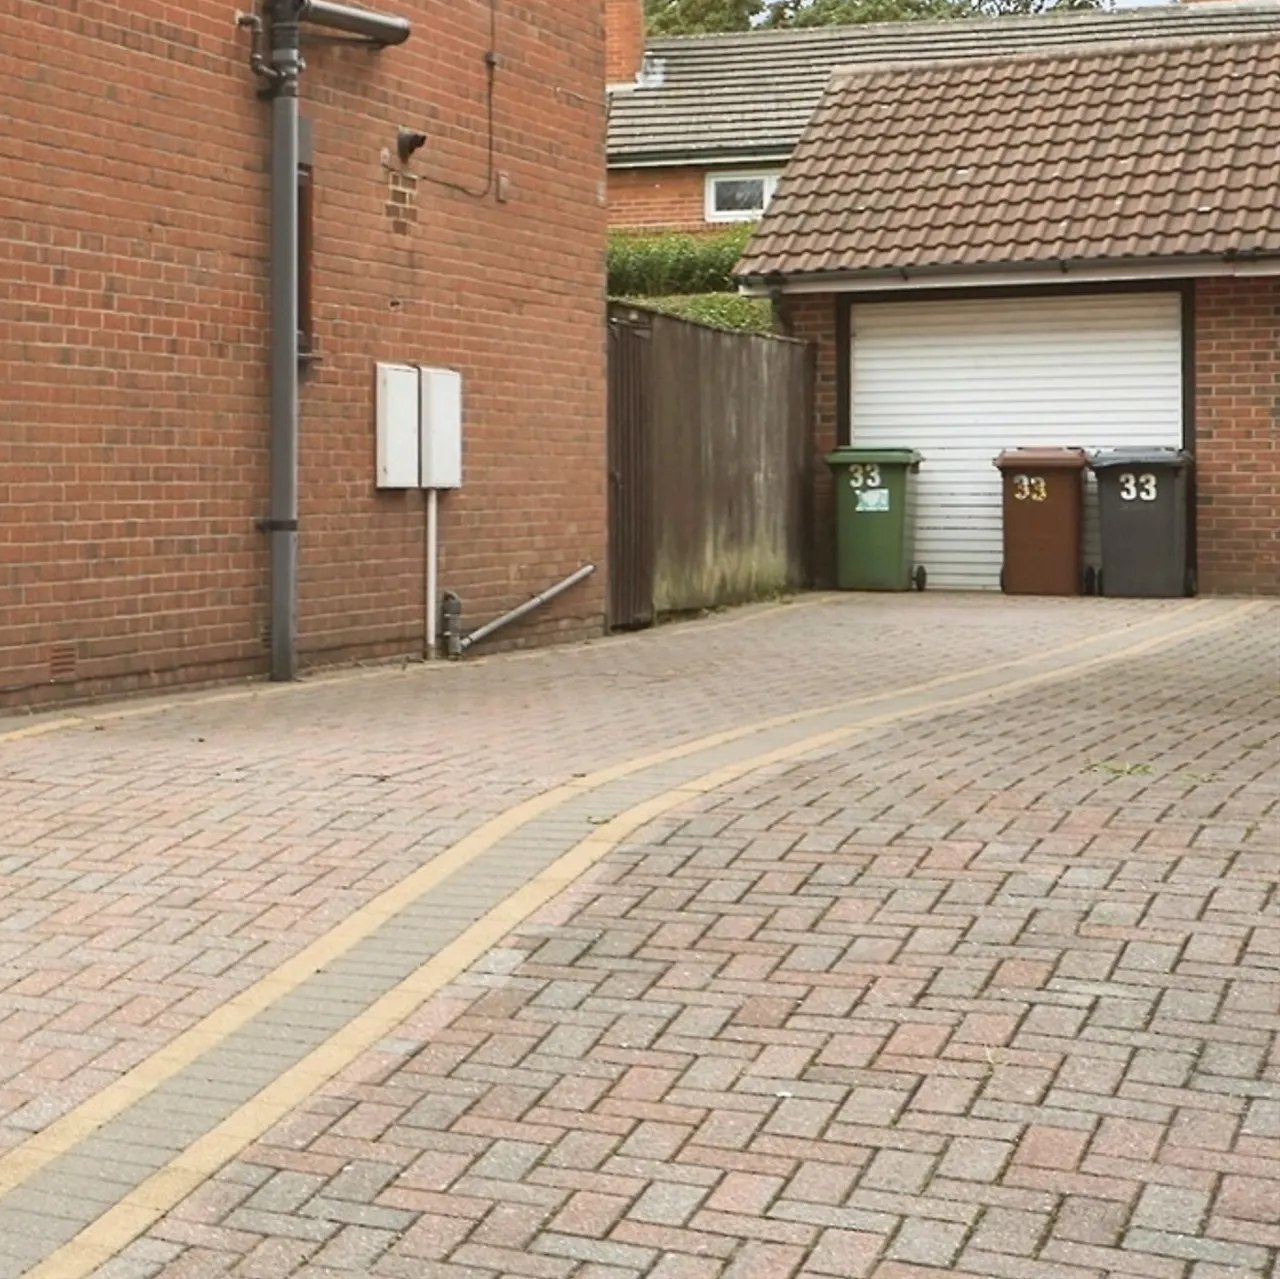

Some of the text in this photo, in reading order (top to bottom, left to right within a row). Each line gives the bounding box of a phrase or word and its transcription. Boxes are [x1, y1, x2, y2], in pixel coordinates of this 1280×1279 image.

[849, 463, 881, 487] 33
[1013, 473, 1047, 502] 33
[1119, 473, 1157, 501] 33
